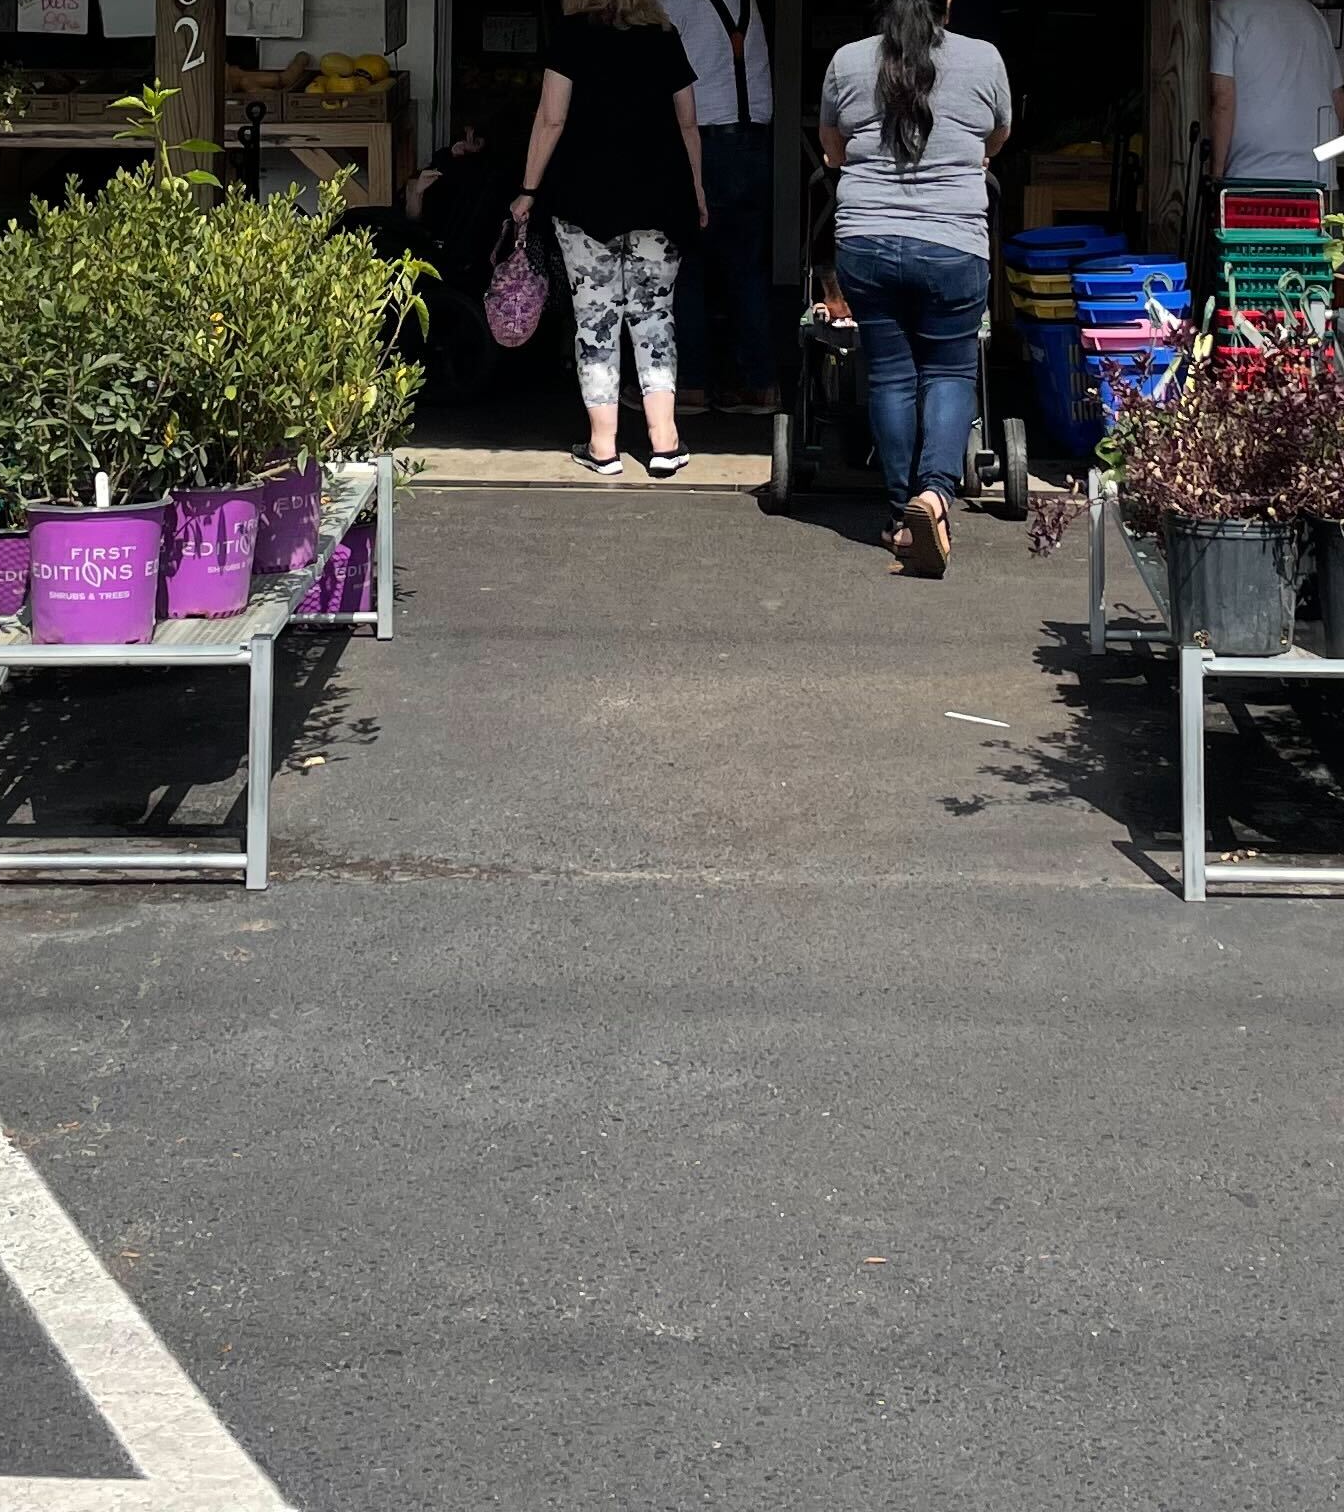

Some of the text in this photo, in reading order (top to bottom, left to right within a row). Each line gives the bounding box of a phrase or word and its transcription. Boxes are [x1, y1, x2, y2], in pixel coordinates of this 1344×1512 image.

[32, 561, 133, 588] EDITIONS
[49, 591, 86, 602] SHRUBS
[99, 590, 131, 602] TREES
